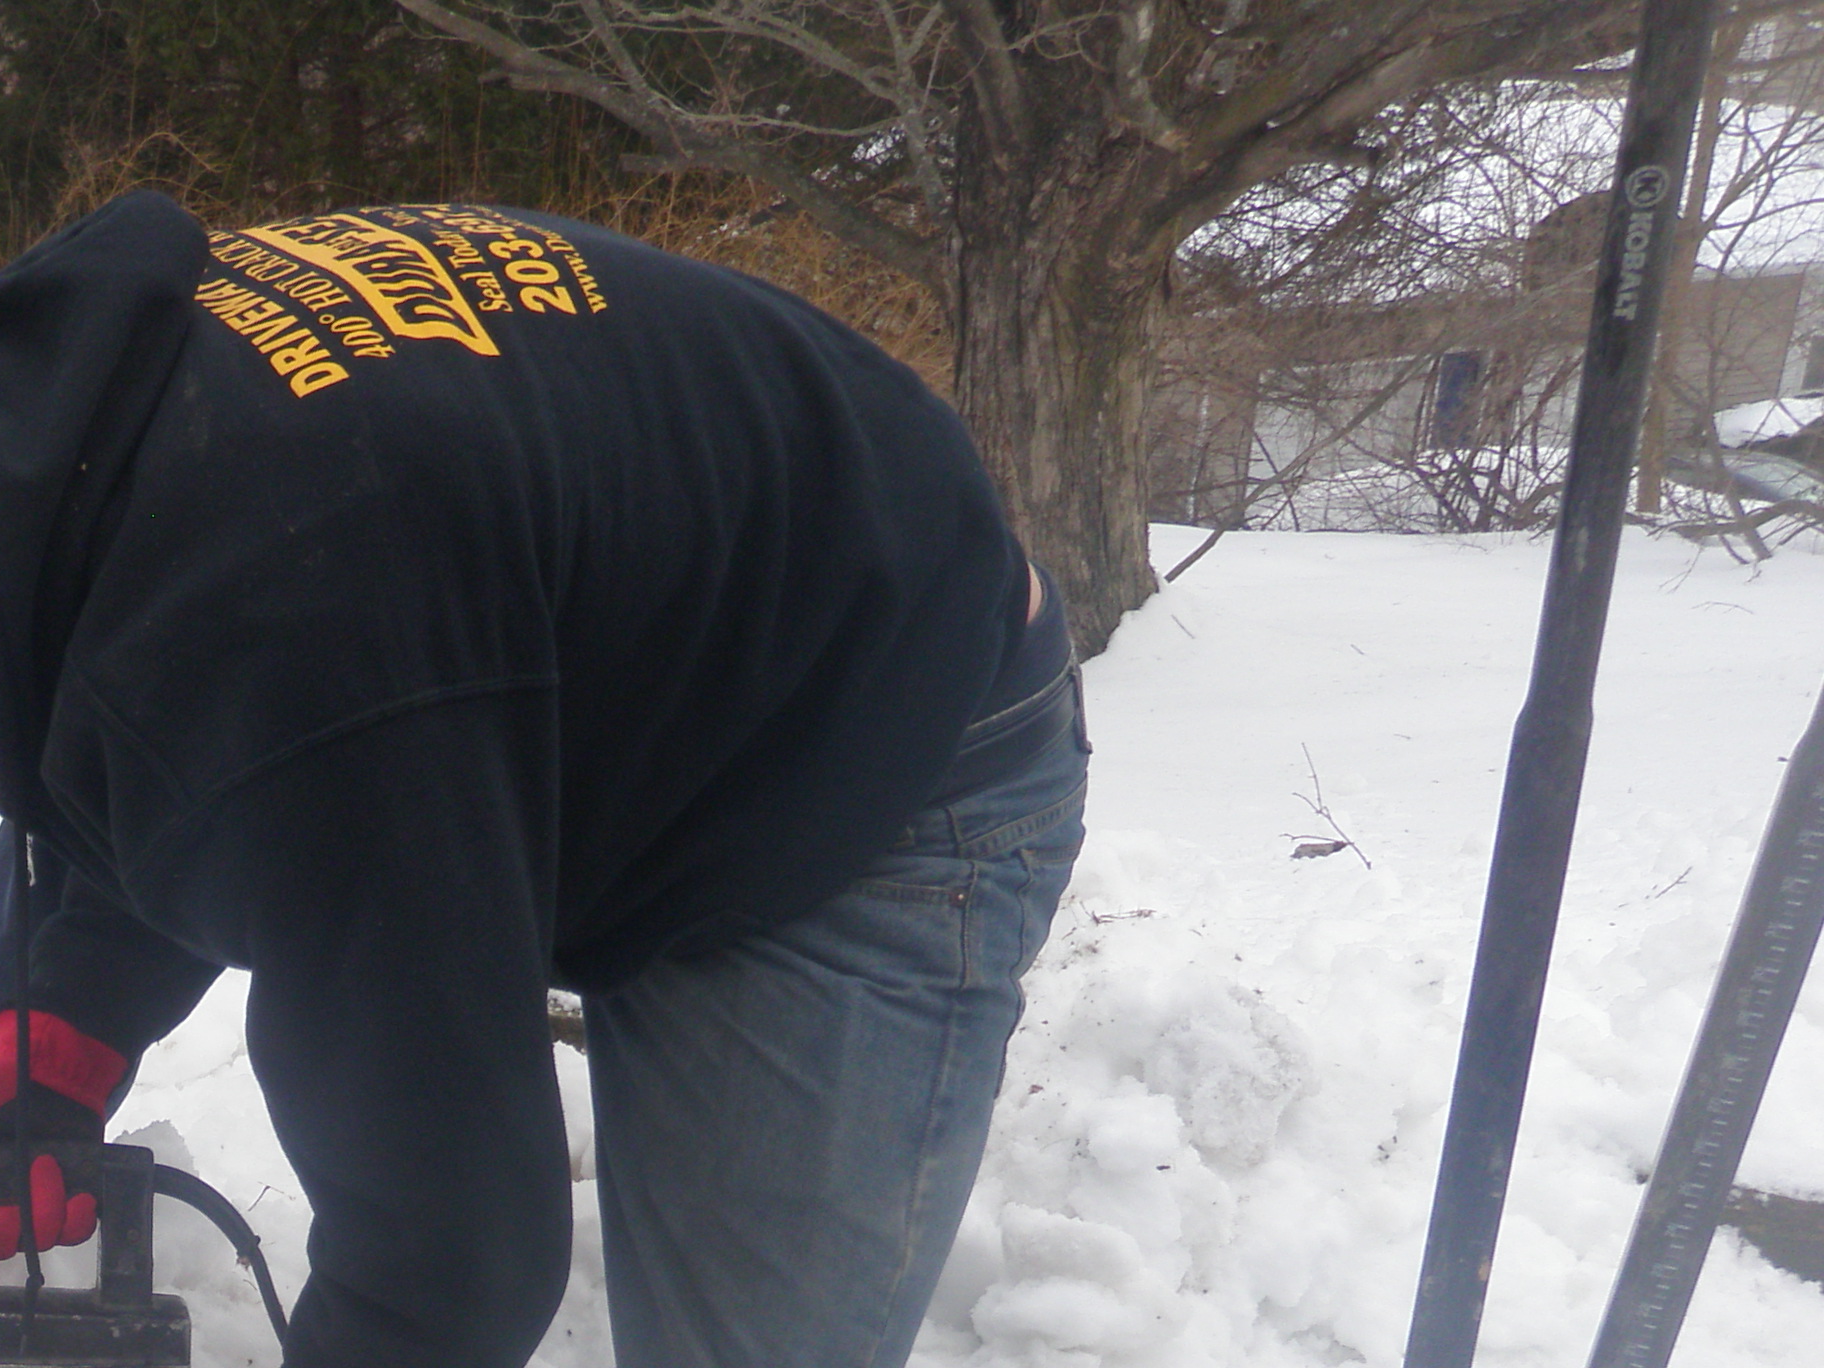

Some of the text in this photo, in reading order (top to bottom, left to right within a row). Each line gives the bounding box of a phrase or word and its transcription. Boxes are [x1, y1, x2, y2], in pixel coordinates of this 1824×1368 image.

[211, 239, 300, 282] CRACK
[1613, 213, 1654, 320] KOBALT
[274, 271, 352, 312] HOT
[459, 271, 514, 313] Seal
